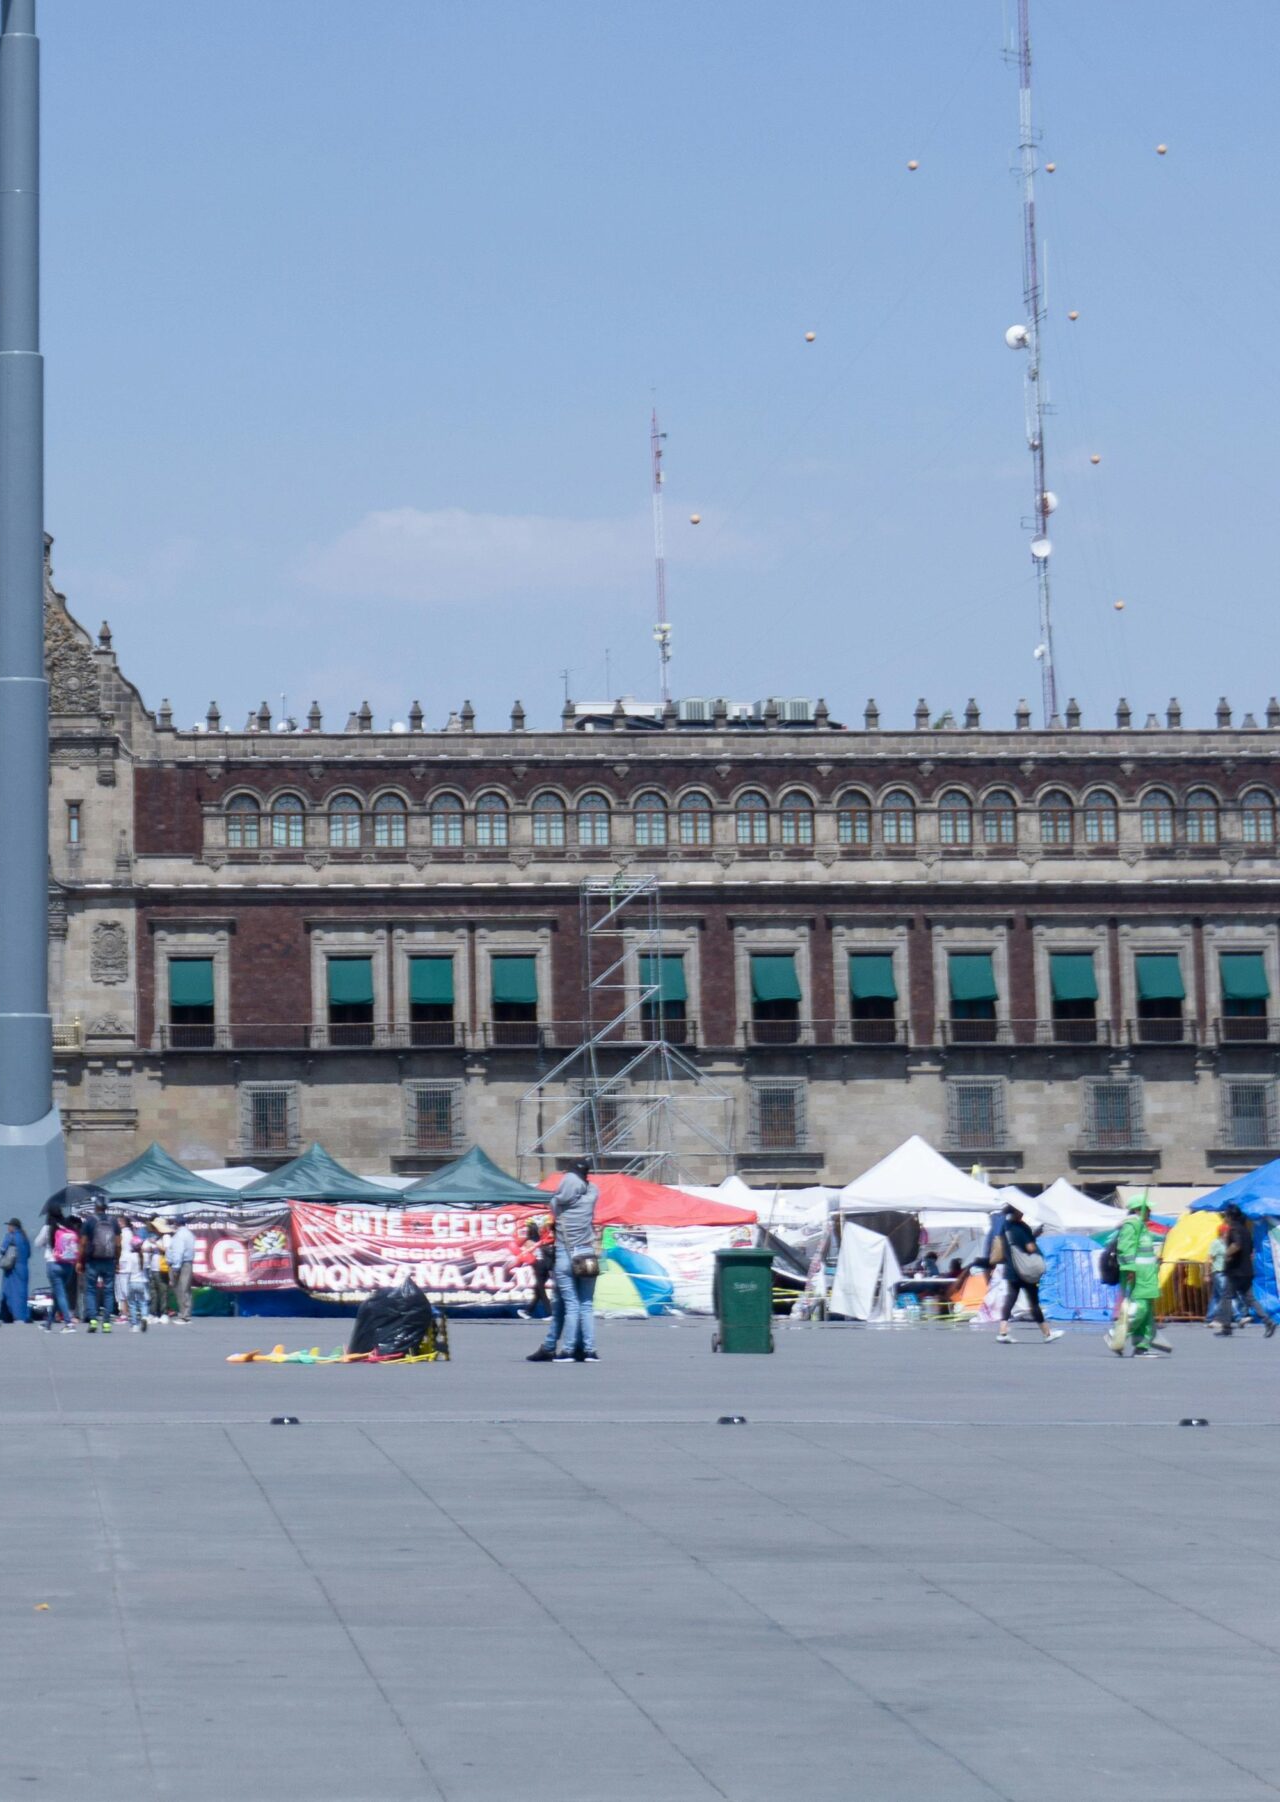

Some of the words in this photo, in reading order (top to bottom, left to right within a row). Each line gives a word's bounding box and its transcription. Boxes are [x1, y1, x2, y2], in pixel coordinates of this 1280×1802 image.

[335, 1210, 402, 1236] CNTE
[431, 1213, 515, 1238] CETEG
[381, 1246, 463, 1260] REGIÓN
